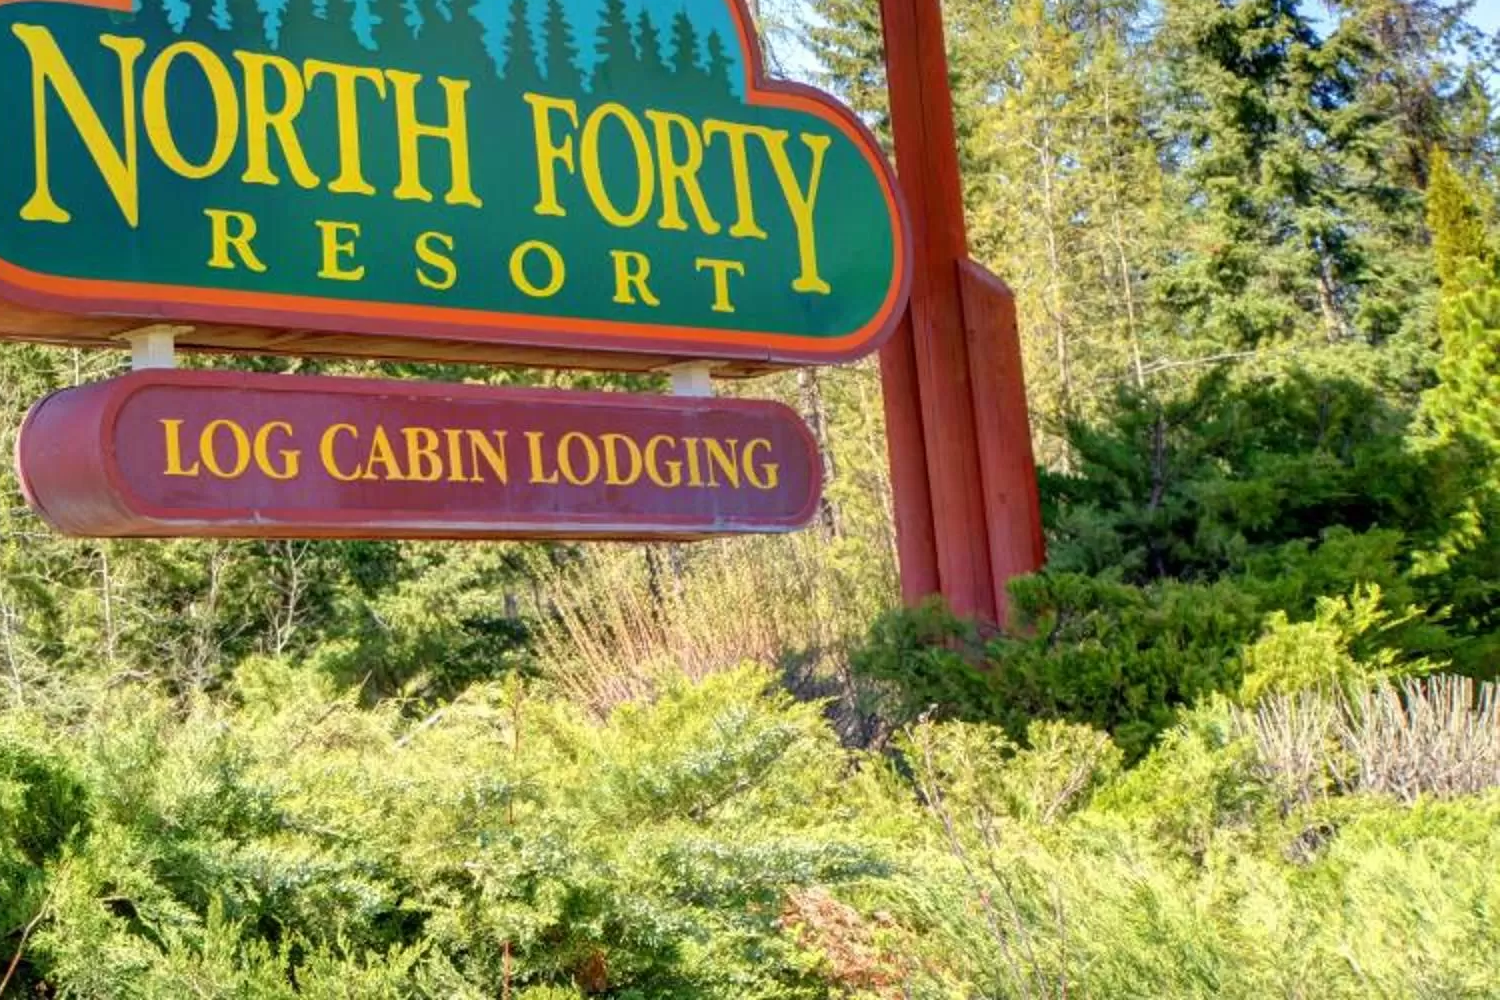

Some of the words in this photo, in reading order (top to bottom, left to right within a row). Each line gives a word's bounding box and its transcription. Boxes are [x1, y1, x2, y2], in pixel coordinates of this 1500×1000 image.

[11, 23, 482, 228] NORTH
[523, 92, 831, 294] FORTY
[204, 209, 746, 314] RESORT
[161, 418, 301, 479] LOG
[319, 423, 508, 484] CABIN
[525, 431, 779, 489] LODGING
